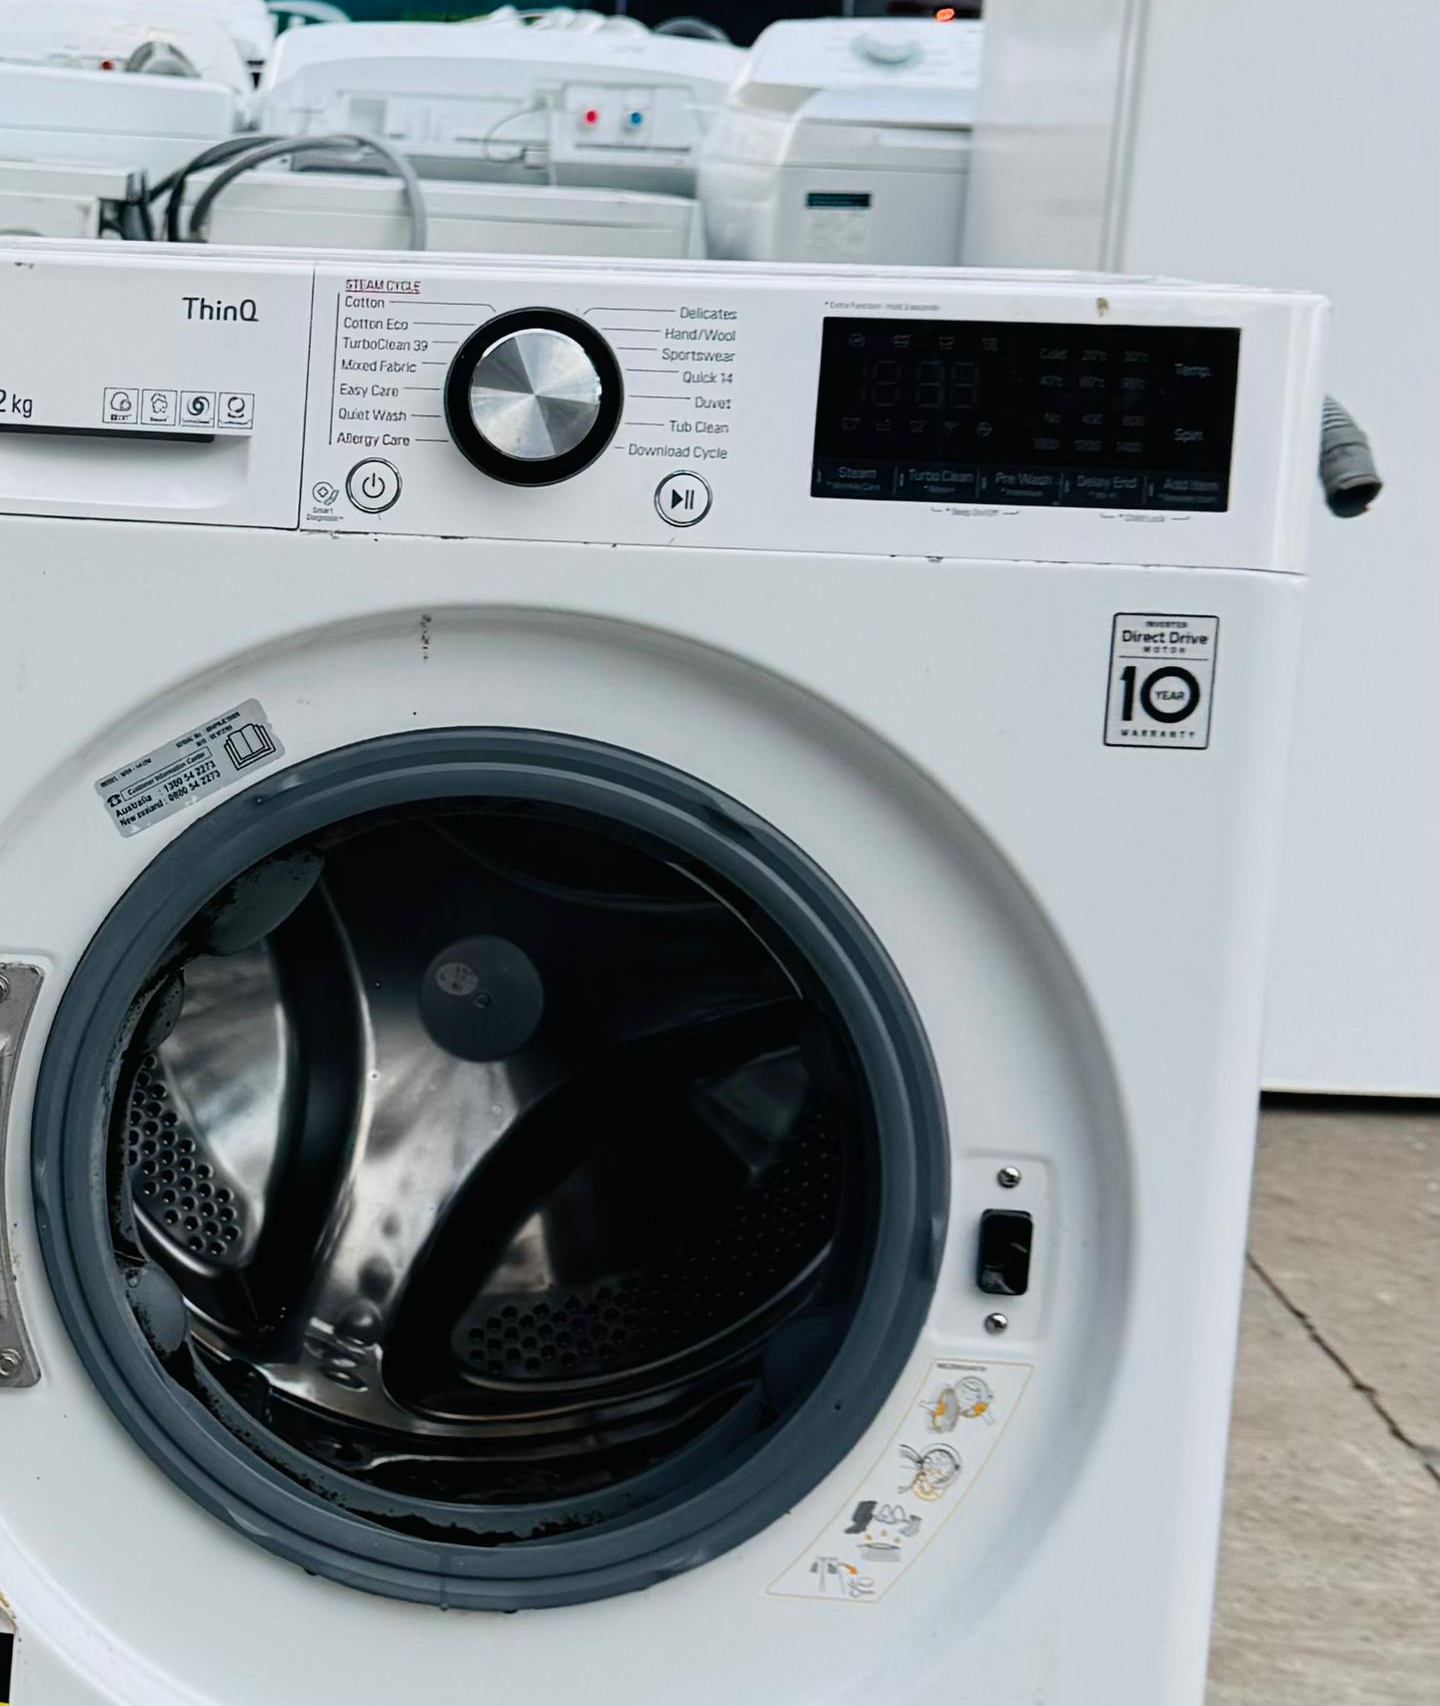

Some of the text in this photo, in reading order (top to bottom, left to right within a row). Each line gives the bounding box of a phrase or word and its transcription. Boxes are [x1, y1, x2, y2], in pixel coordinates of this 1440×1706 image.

[345, 279, 421, 292] STEAM CYCLE
[345, 295, 385, 308] Cotton
[183, 297, 259, 322] ThinQ
[679, 306, 738, 320] Delicates
[344, 317, 409, 330] Cotton Eco
[664, 328, 736, 341] Hand/Wool
[343, 336, 429, 351] TurboClean 39
[662, 348, 736, 362] Sportswear
[341, 359, 417, 373] Mixed Fabric
[682, 370, 717, 383] Quick
[340, 383, 399, 397] Easy Care
[11, 394, 33, 418] kg
[694, 396, 731, 410] Duvet
[338, 407, 407, 421] Quiet Wash
[669, 419, 729, 434] Tub Clean
[337, 432, 410, 447] Allergy Care
[628, 443, 728, 461] Download Cycle
[838, 465, 878, 480] Steam
[908, 468, 974, 484] Turbo Clean
[1122, 629, 1209, 645] Direct Drive
[1120, 665, 1200, 723] 10
[1155, 690, 1185, 701] YEAR
[1120, 729, 1195, 739] WARRANTY
[116, 794, 153, 818] Australia
[120, 813, 137, 827] New
